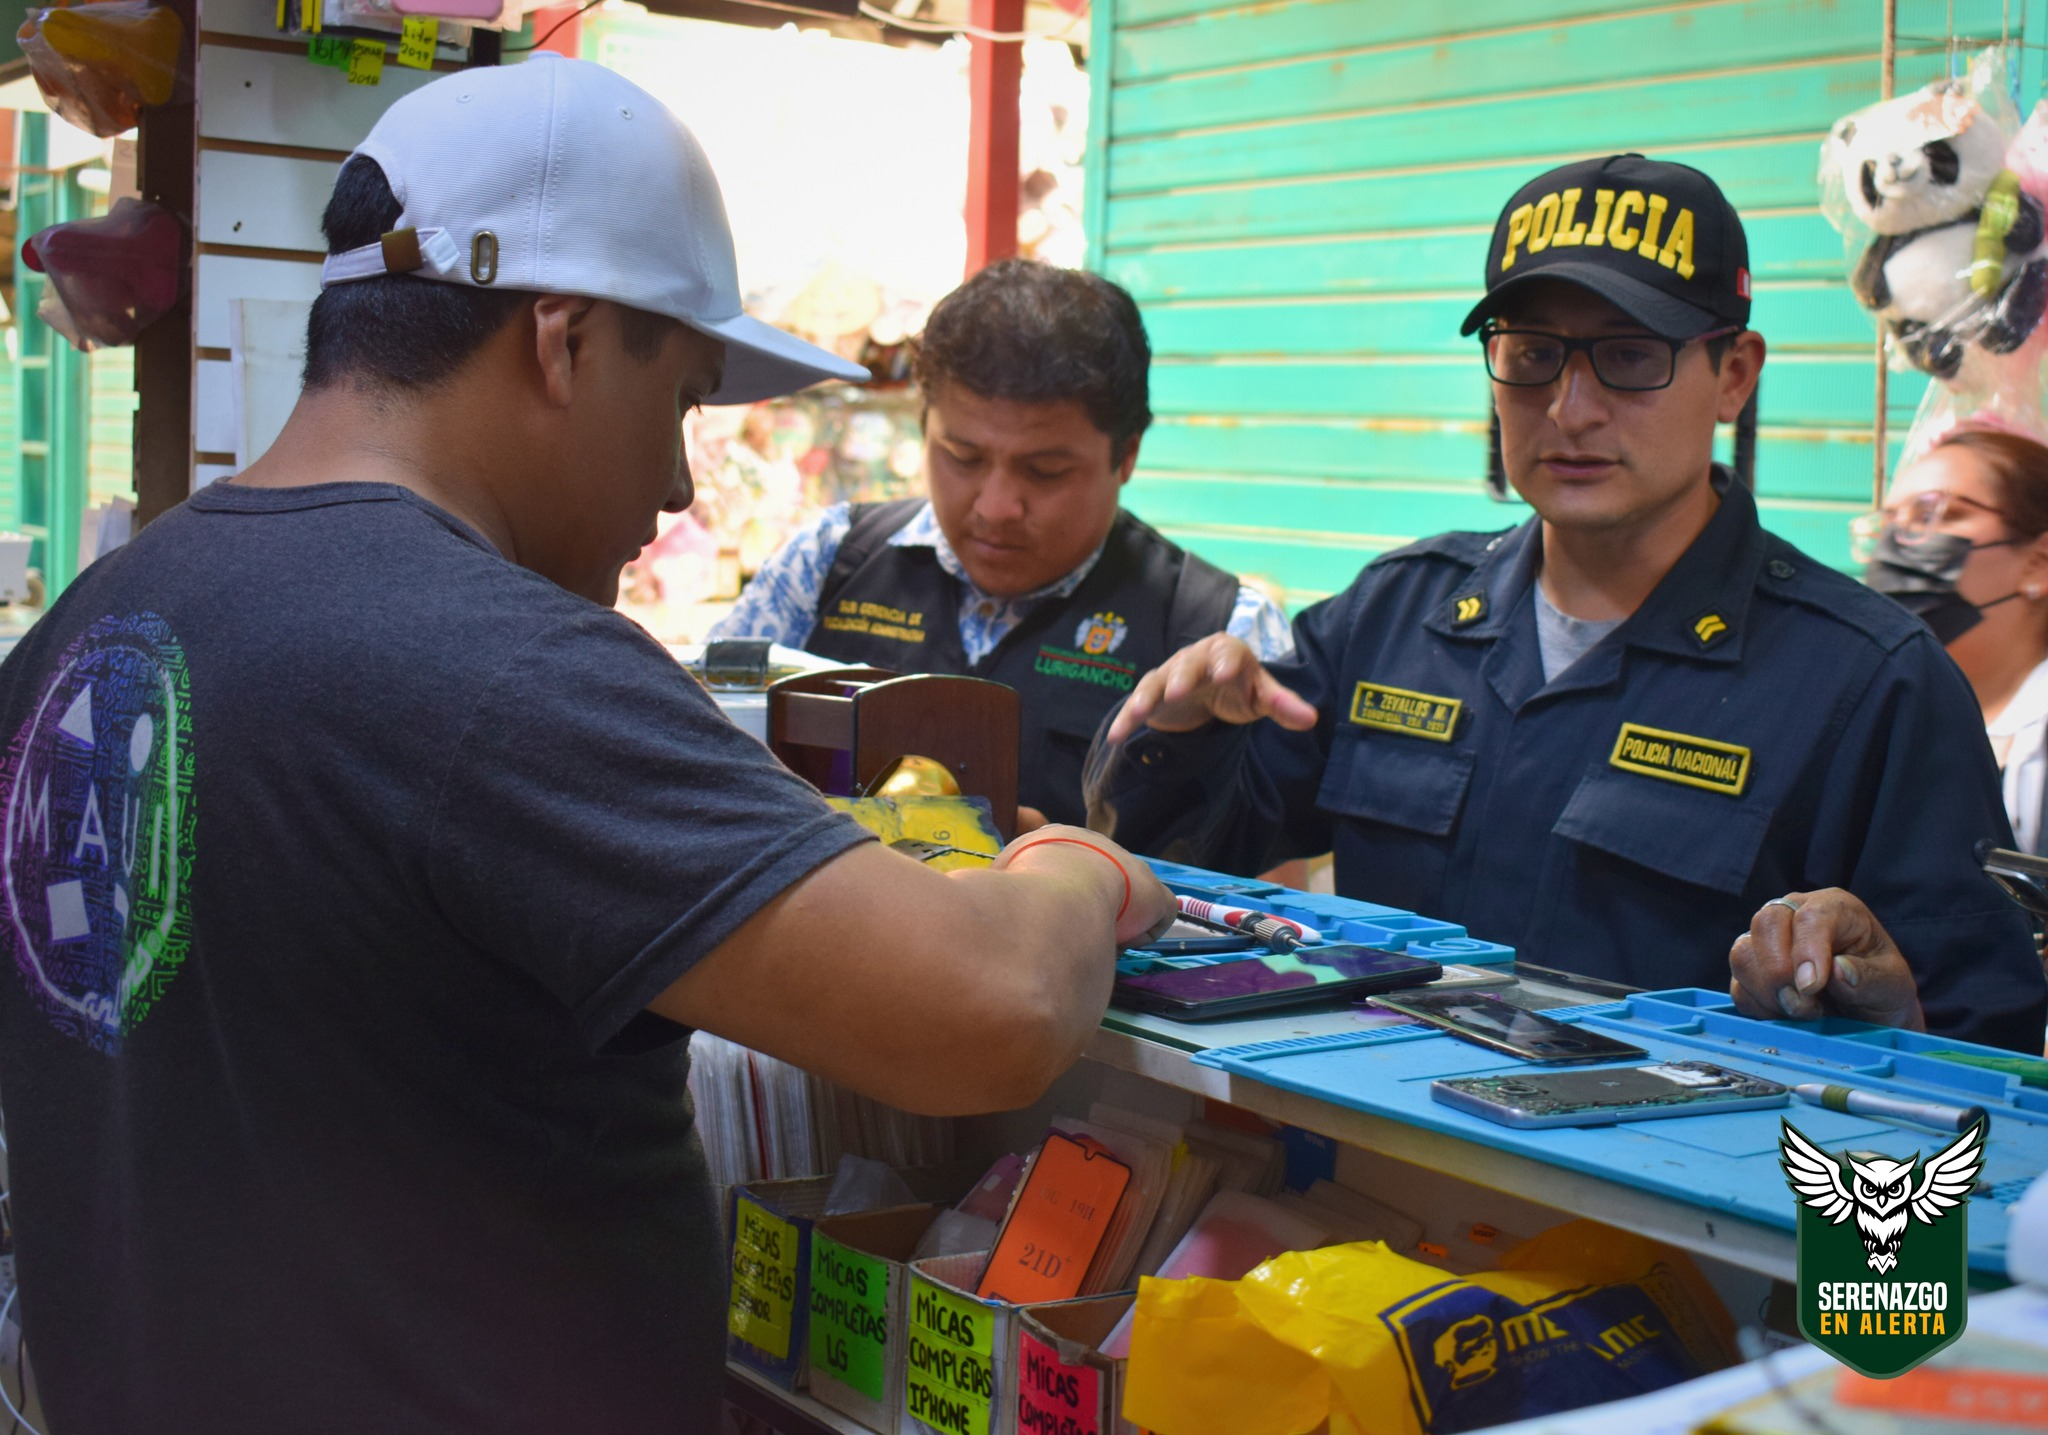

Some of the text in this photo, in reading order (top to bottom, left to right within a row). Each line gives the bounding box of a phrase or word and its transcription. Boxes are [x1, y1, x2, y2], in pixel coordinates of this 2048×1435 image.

[1501, 187, 1695, 281] POLICIA
[1034, 655, 1134, 691] LURIGANCHO
[1379, 693, 1431, 718] ZEVALLOS
[1621, 737, 1738, 781] POLICIA NACIONAL
[18, 772, 164, 898] MAUI
[826, 1333, 849, 1372] LG
[909, 1336, 994, 1399] COMPLETAS
